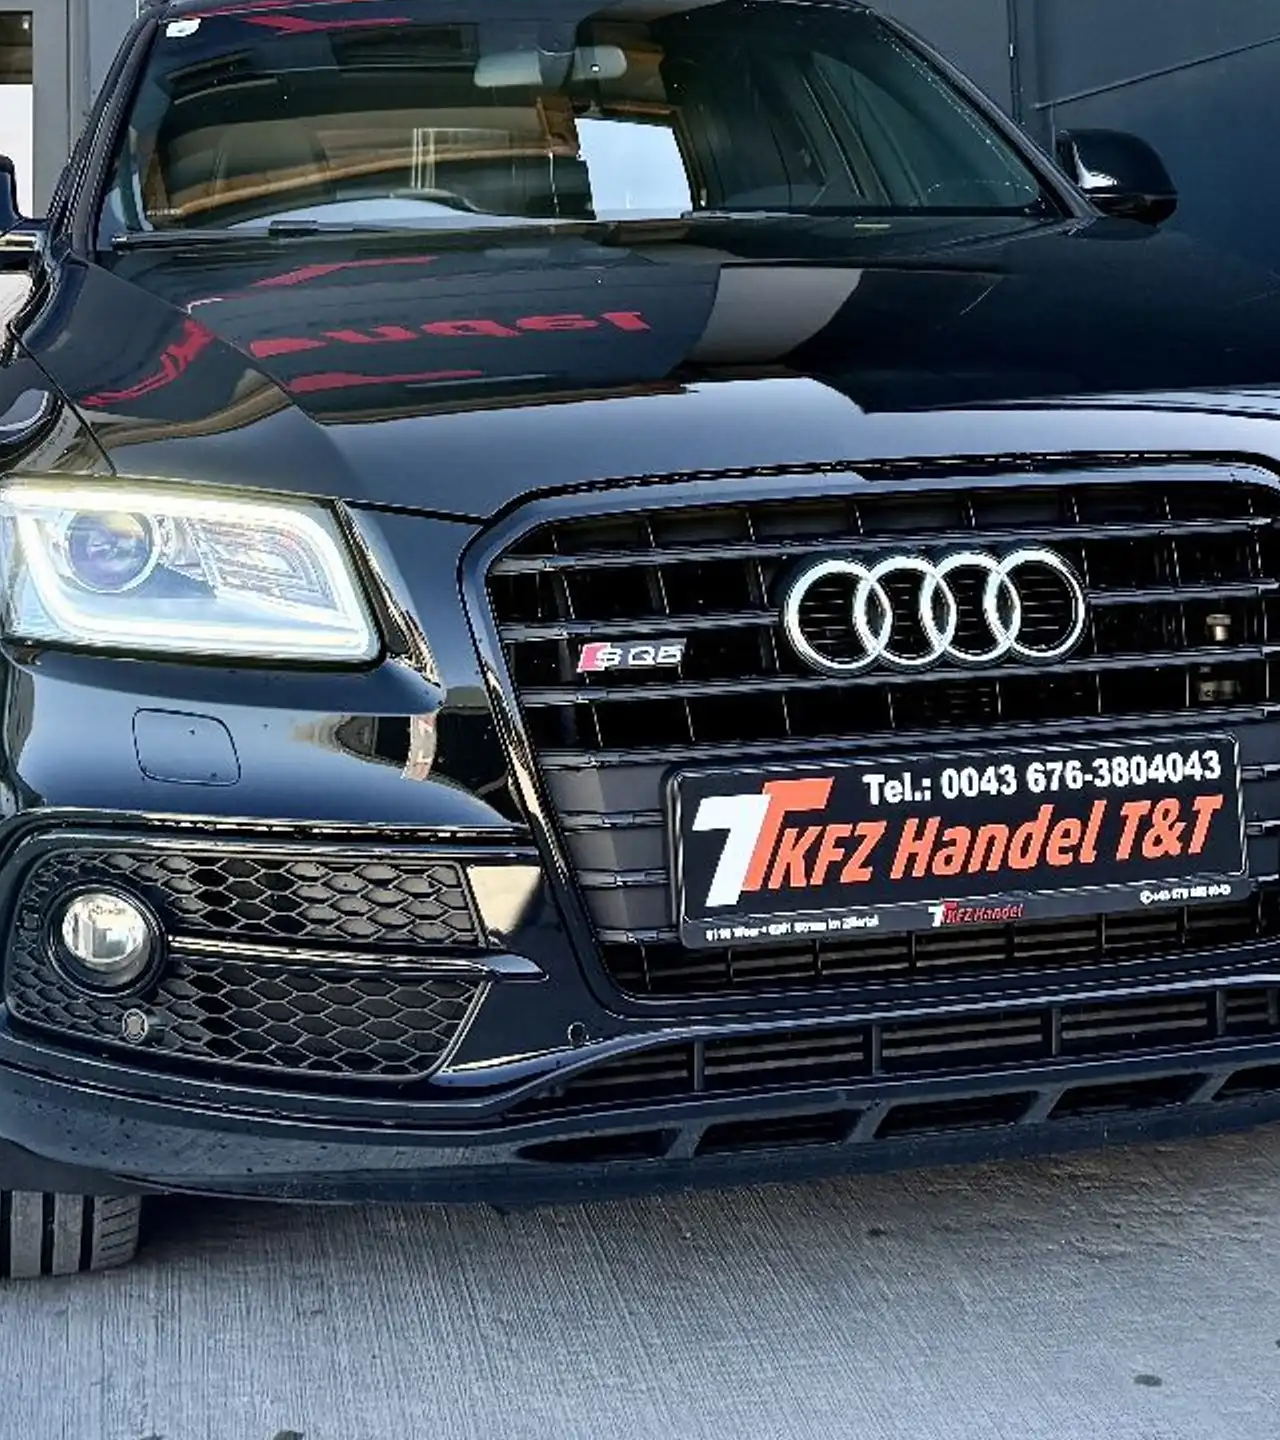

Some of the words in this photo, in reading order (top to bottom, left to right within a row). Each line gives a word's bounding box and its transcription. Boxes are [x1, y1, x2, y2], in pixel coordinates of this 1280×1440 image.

[592, 643, 685, 669] SQ5
[862, 772, 933, 806] Tel.:
[939, 763, 1018, 800] 0043
[1025, 749, 1222, 794] 676-3804043
[767, 820, 887, 890] KFZ
[889, 798, 1108, 880] Handel
[1114, 794, 1224, 861] T&T
